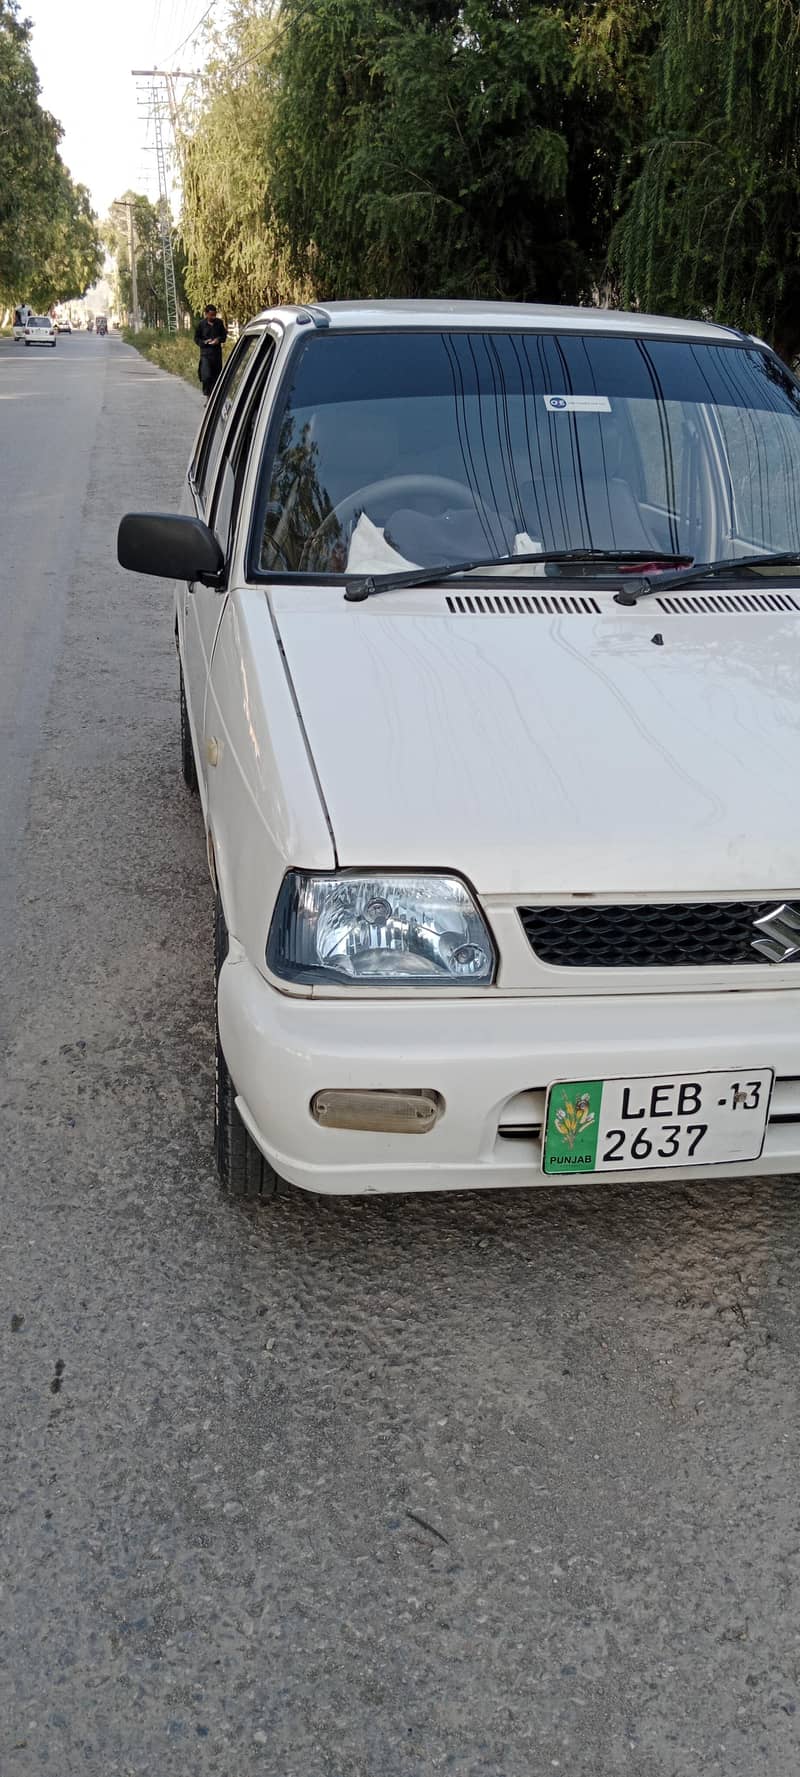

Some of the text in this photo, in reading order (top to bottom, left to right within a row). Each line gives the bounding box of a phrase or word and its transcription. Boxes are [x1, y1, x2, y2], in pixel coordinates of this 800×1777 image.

[621, 1083, 702, 1120] LEB
[550, 1155, 592, 1165] PUNJAB
[602, 1124, 708, 1162] 2637
